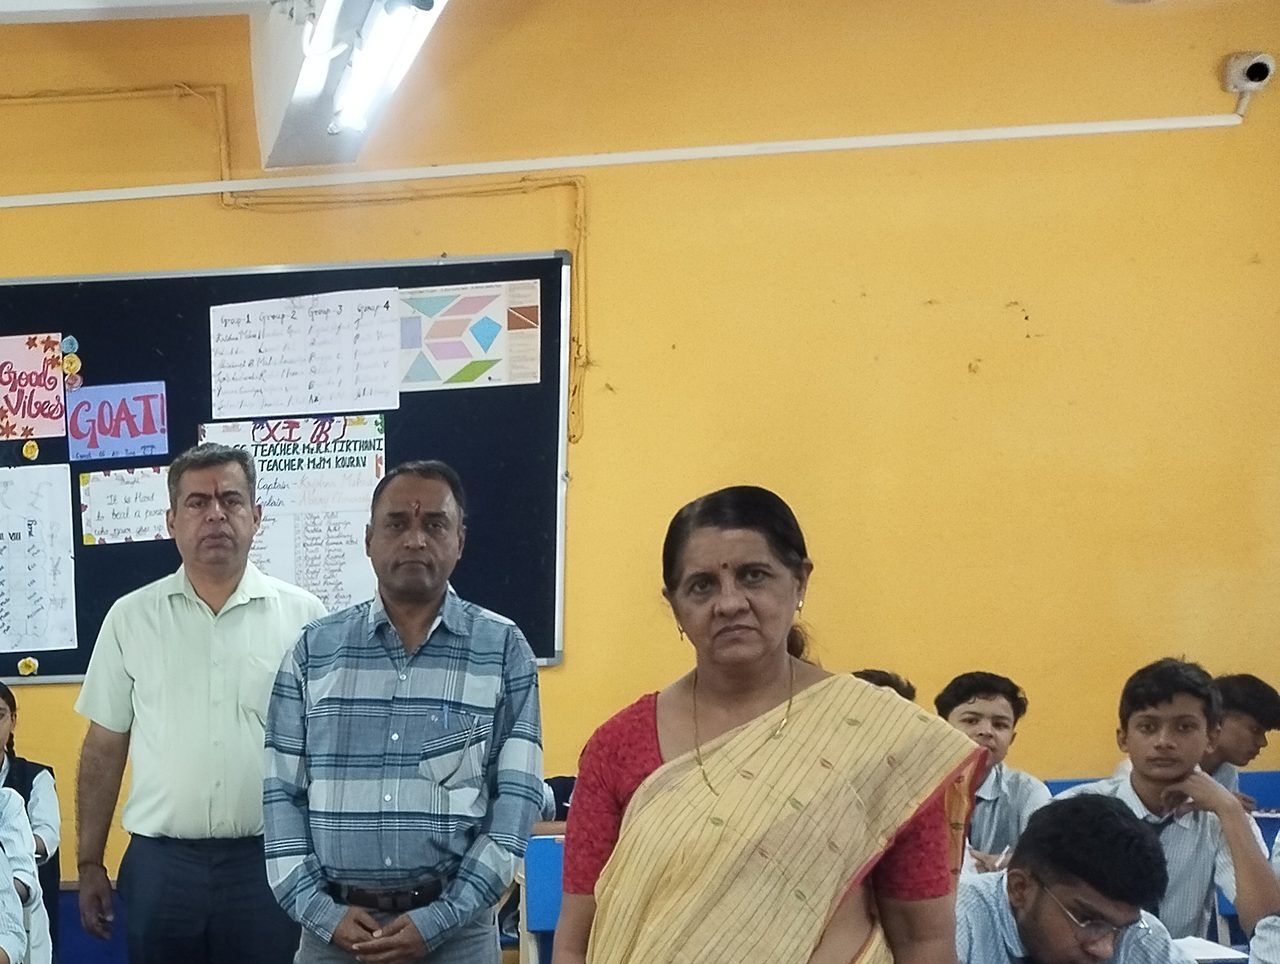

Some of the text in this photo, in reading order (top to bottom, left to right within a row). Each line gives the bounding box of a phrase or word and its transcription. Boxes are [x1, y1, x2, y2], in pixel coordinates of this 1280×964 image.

[3, 389, 64, 420] Vibes
[69, 393, 167, 449] GOAT!
[251, 442, 300, 458] TEACHER
[258, 457, 305, 472] TEACHER
